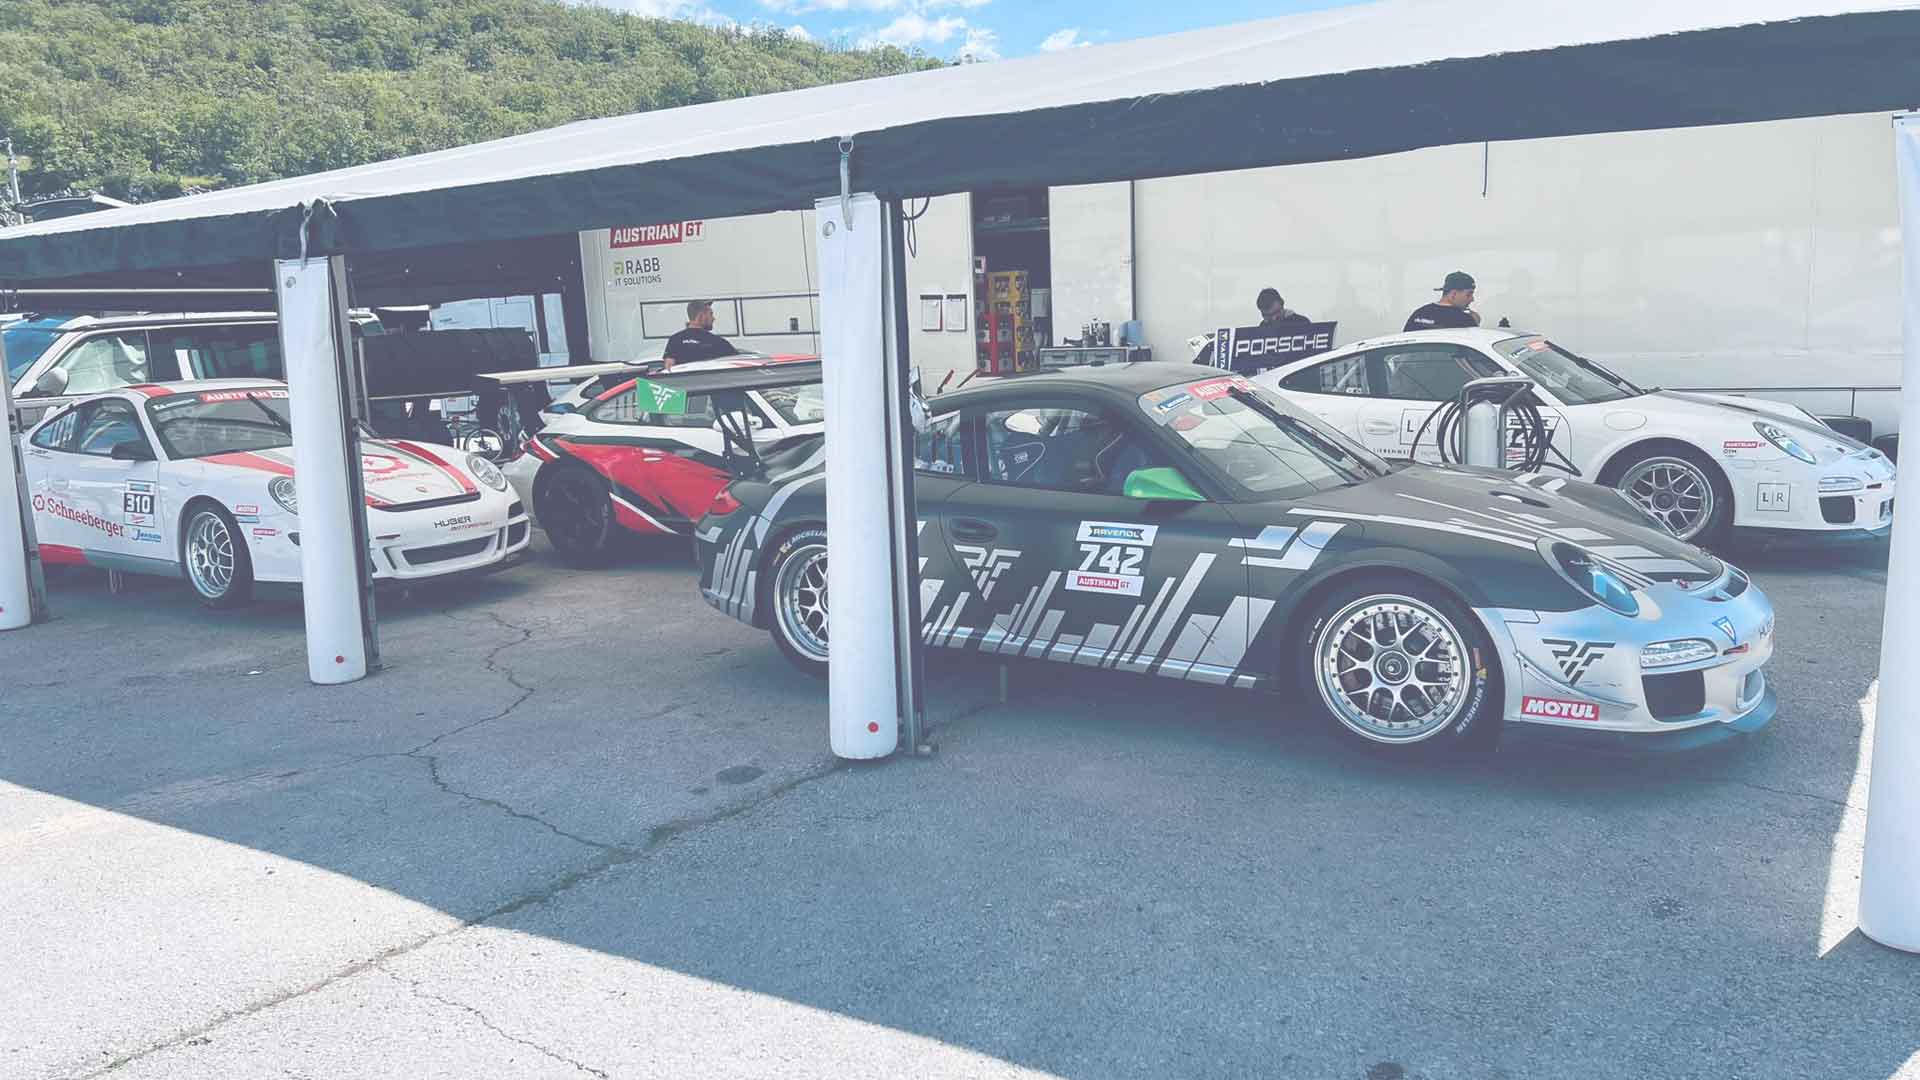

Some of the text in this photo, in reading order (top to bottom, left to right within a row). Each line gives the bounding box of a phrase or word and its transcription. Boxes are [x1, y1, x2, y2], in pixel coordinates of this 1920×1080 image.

[614, 221, 702, 244] AUSTRIAN GT
[625, 257, 660, 274] RABB
[624, 275, 662, 286] SOLUTIONS
[1235, 333, 1329, 358] PORSCHE
[1219, 342, 1227, 369] VARTA
[126, 494, 152, 513] 310
[47, 497, 125, 537] Schneeberger
[434, 515, 472, 528] HUBER
[1093, 527, 1140, 538] RAVENOL
[1078, 543, 1145, 575] 742
[1079, 576, 1118, 589] AUSTRIAN
[1525, 699, 1596, 718] MOTUL
